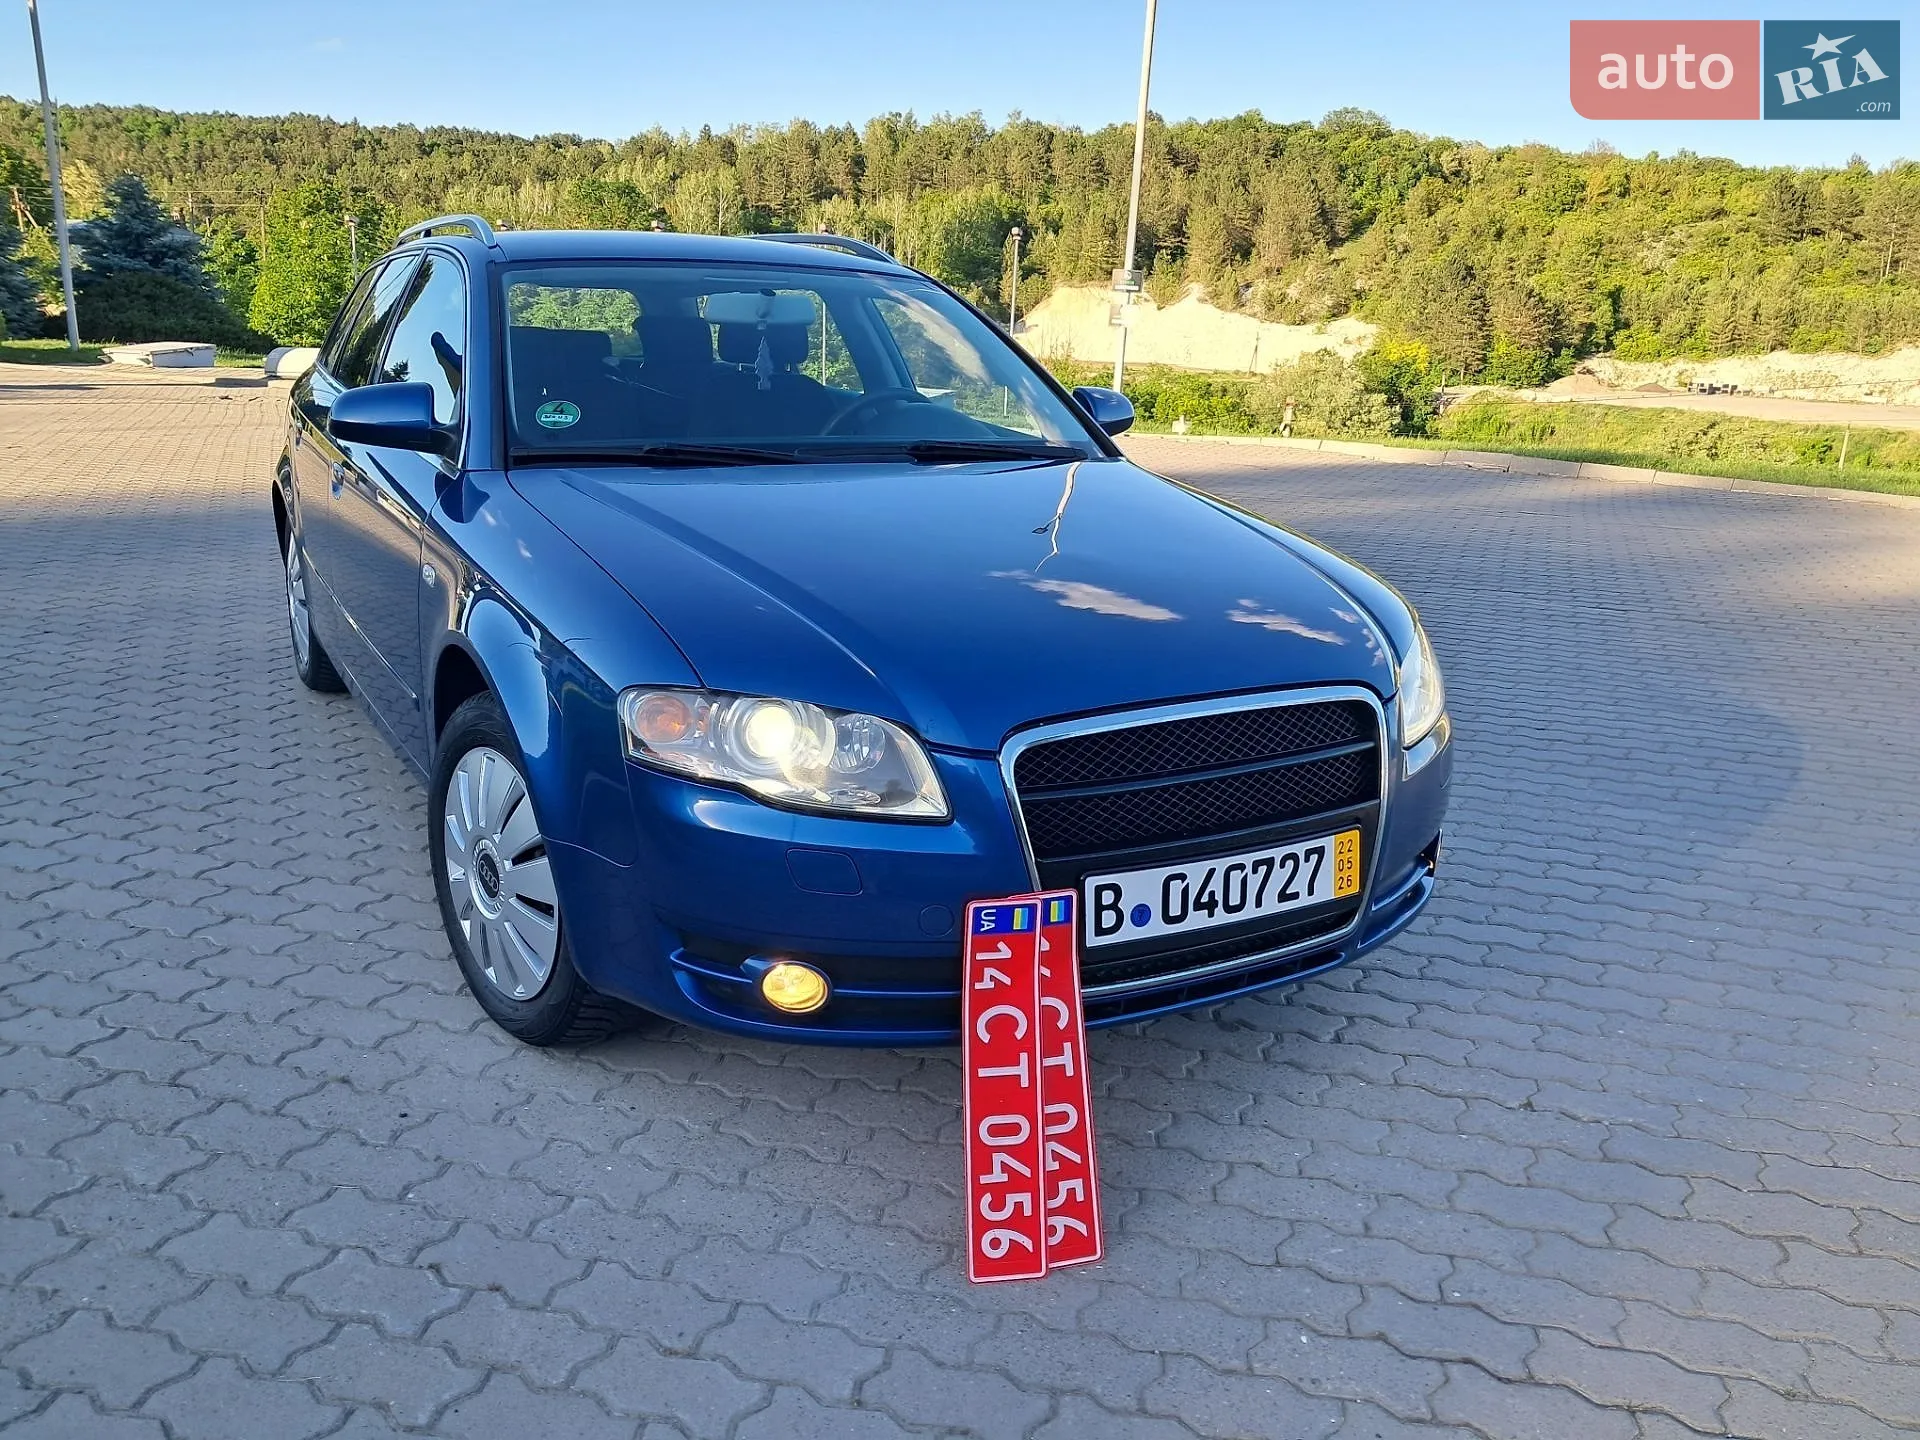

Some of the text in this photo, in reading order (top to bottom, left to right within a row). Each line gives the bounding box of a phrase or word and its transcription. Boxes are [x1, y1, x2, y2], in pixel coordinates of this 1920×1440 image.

[553, 402, 565, 414] 4
[1337, 839, 1353, 854] 22
[1337, 856, 1353, 872] 05
[1337, 875, 1353, 890] 26
[1094, 845, 1326, 937] B 040727
[980, 909, 996, 932] UA
[974, 941, 1034, 1260] 14 CT 0456
